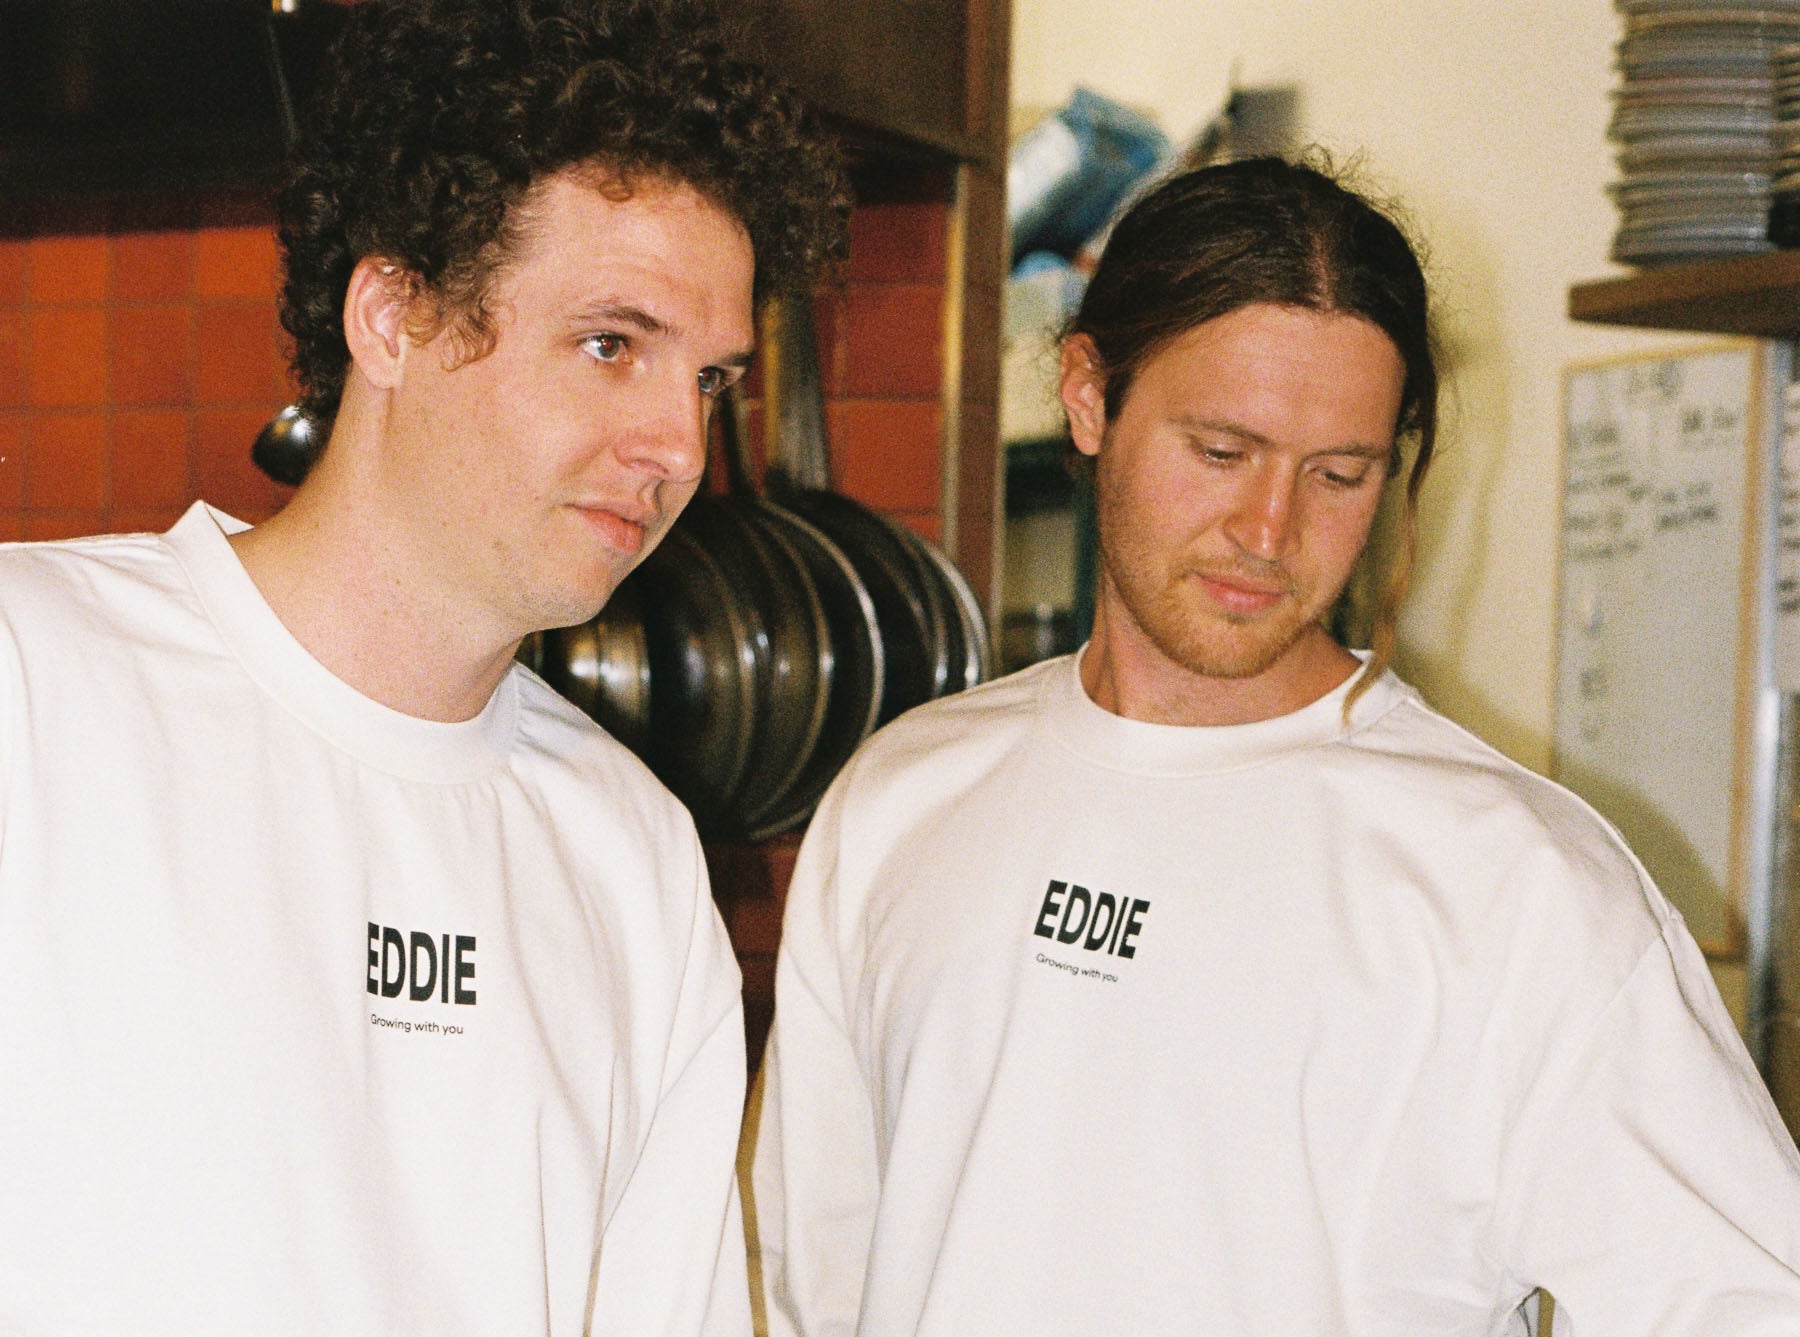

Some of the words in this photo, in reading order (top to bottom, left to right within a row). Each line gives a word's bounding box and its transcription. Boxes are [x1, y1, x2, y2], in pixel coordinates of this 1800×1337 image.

[1034, 879, 1151, 960] EDDIE
[366, 921, 477, 1006] EDDIE
[1036, 952, 1079, 976] Growing
[1081, 967, 1100, 978] with
[1102, 972, 1119, 983] you
[370, 1013, 412, 1033] Growing
[414, 1020, 440, 1033] with
[442, 1026, 464, 1036] you
